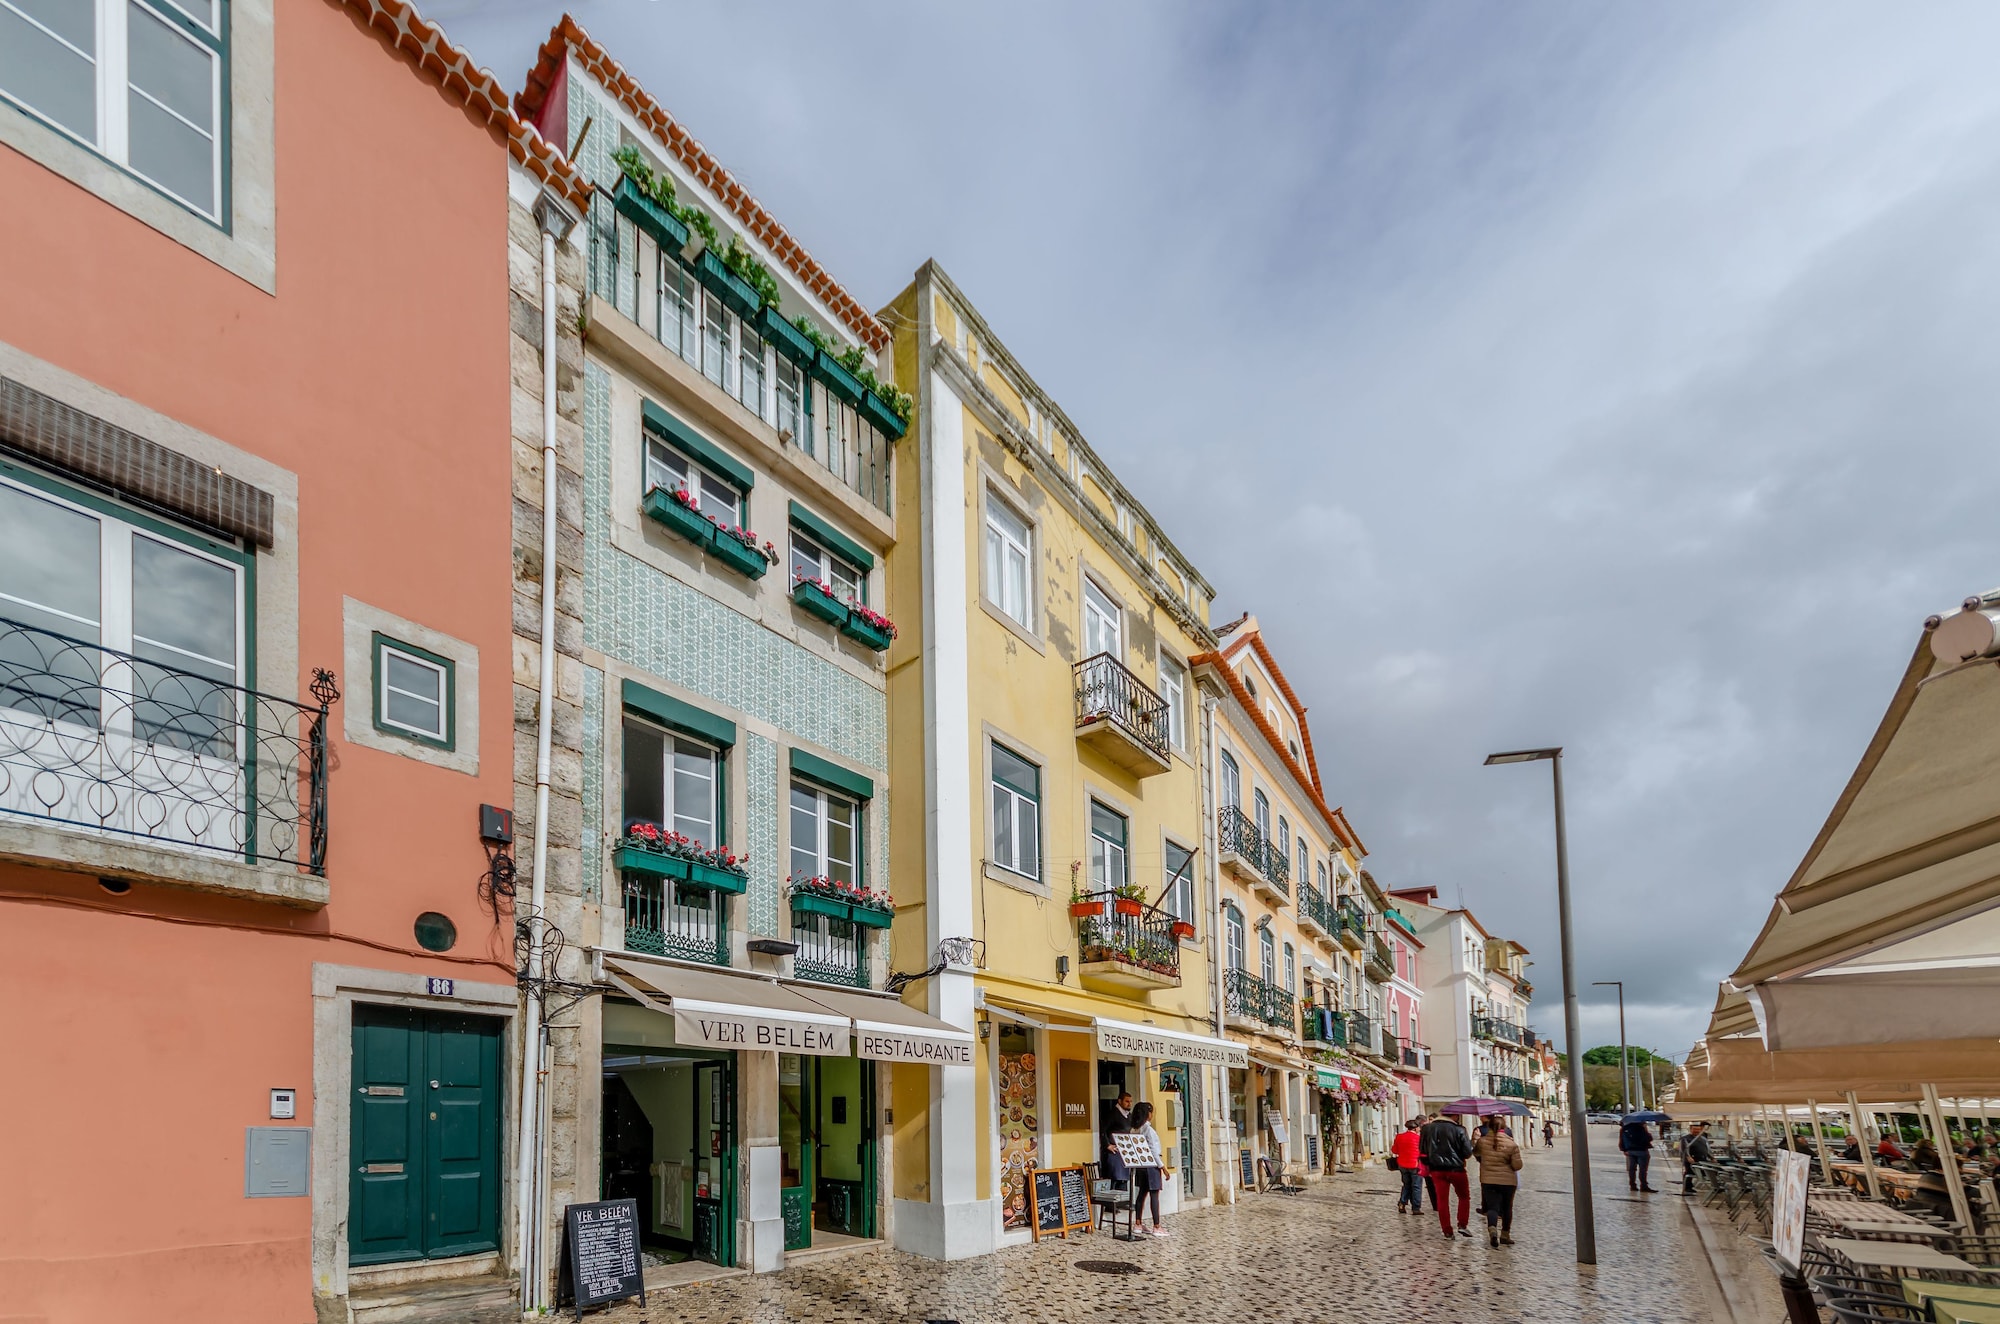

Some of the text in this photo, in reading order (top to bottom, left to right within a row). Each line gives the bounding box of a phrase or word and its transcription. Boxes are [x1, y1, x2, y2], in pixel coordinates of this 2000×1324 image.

[432, 978, 450, 995] 86
[698, 1019, 834, 1050] VER BELÉM
[864, 1037, 970, 1062] RESTAURANTE
[1104, 1033, 1246, 1064] RESTAURANTE CHURRASQUEIRA DINA
[1065, 1103, 1086, 1115] DINA
[576, 1205, 630, 1222] VER BELÉM
